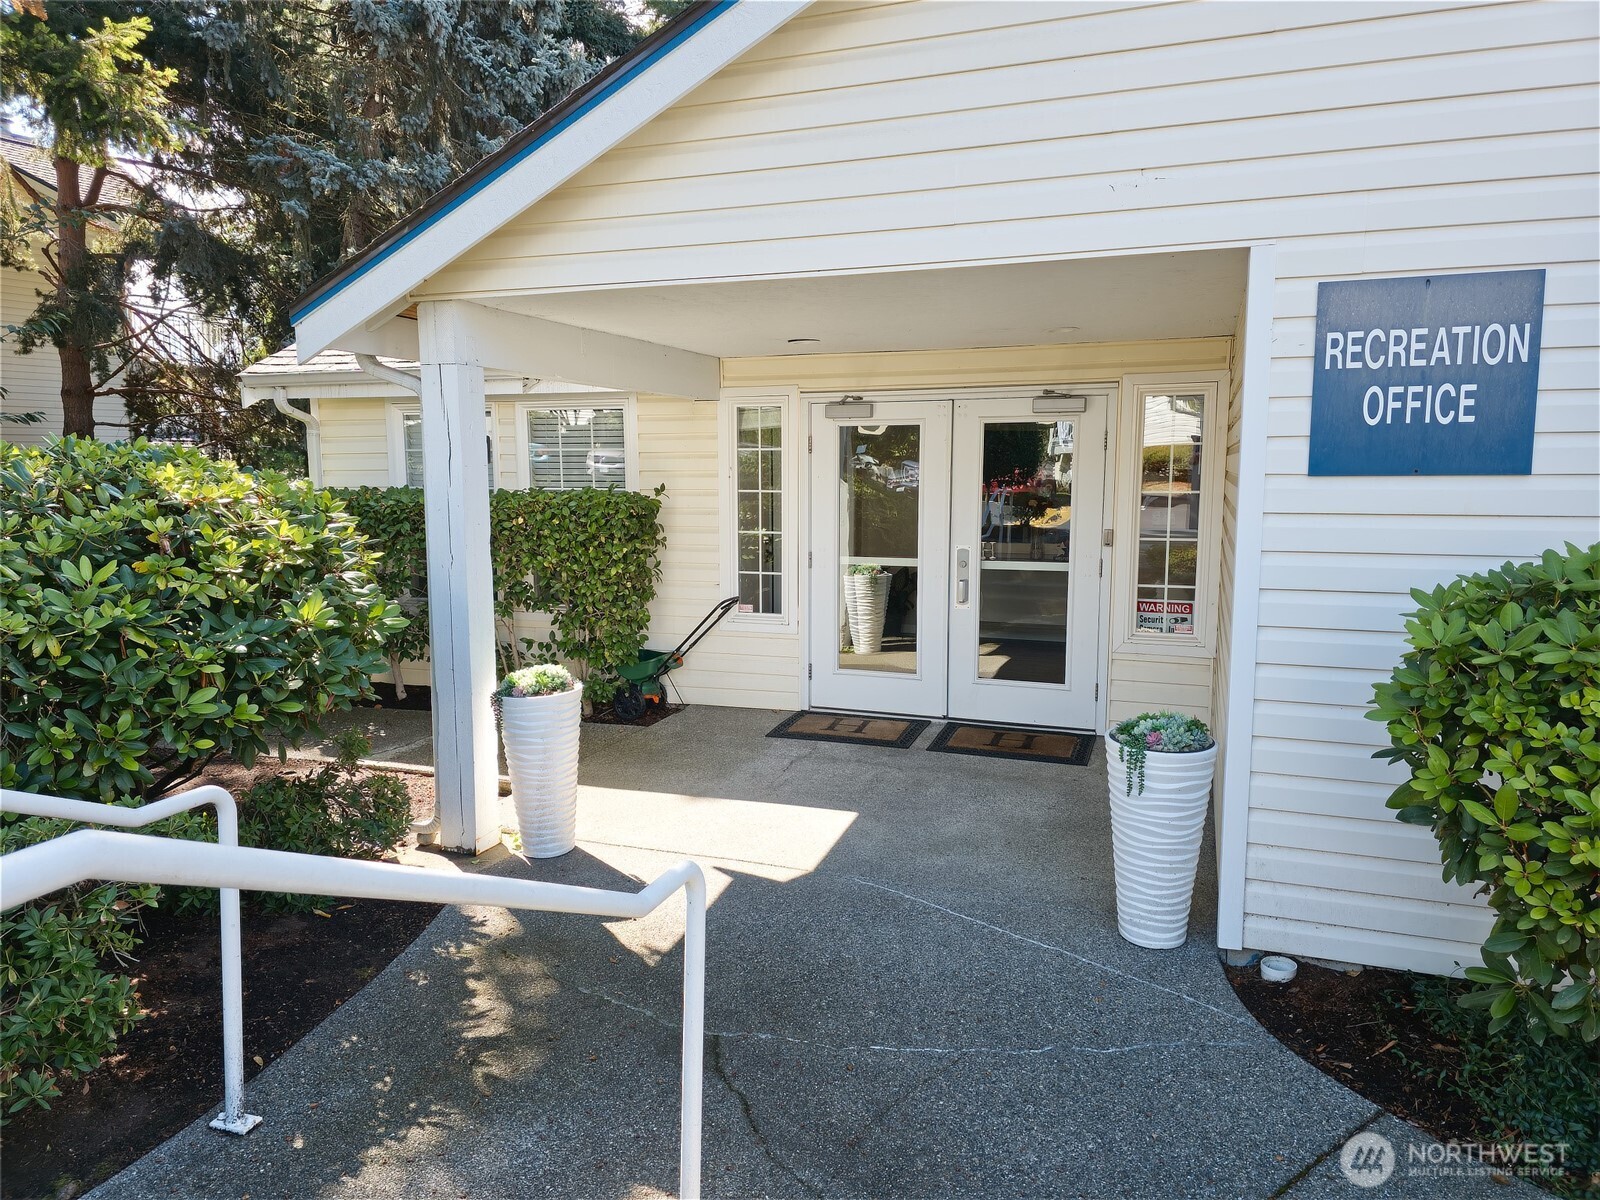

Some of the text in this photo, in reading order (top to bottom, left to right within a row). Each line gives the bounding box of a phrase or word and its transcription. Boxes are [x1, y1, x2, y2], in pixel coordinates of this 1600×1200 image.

[1325, 323, 1531, 370] RECREATION
[1362, 382, 1478, 426] OFFICE
[1139, 602, 1190, 613] WARNING
[1139, 615, 1168, 624] Securit
[820, 717, 878, 734] H
[983, 732, 1041, 749] H
